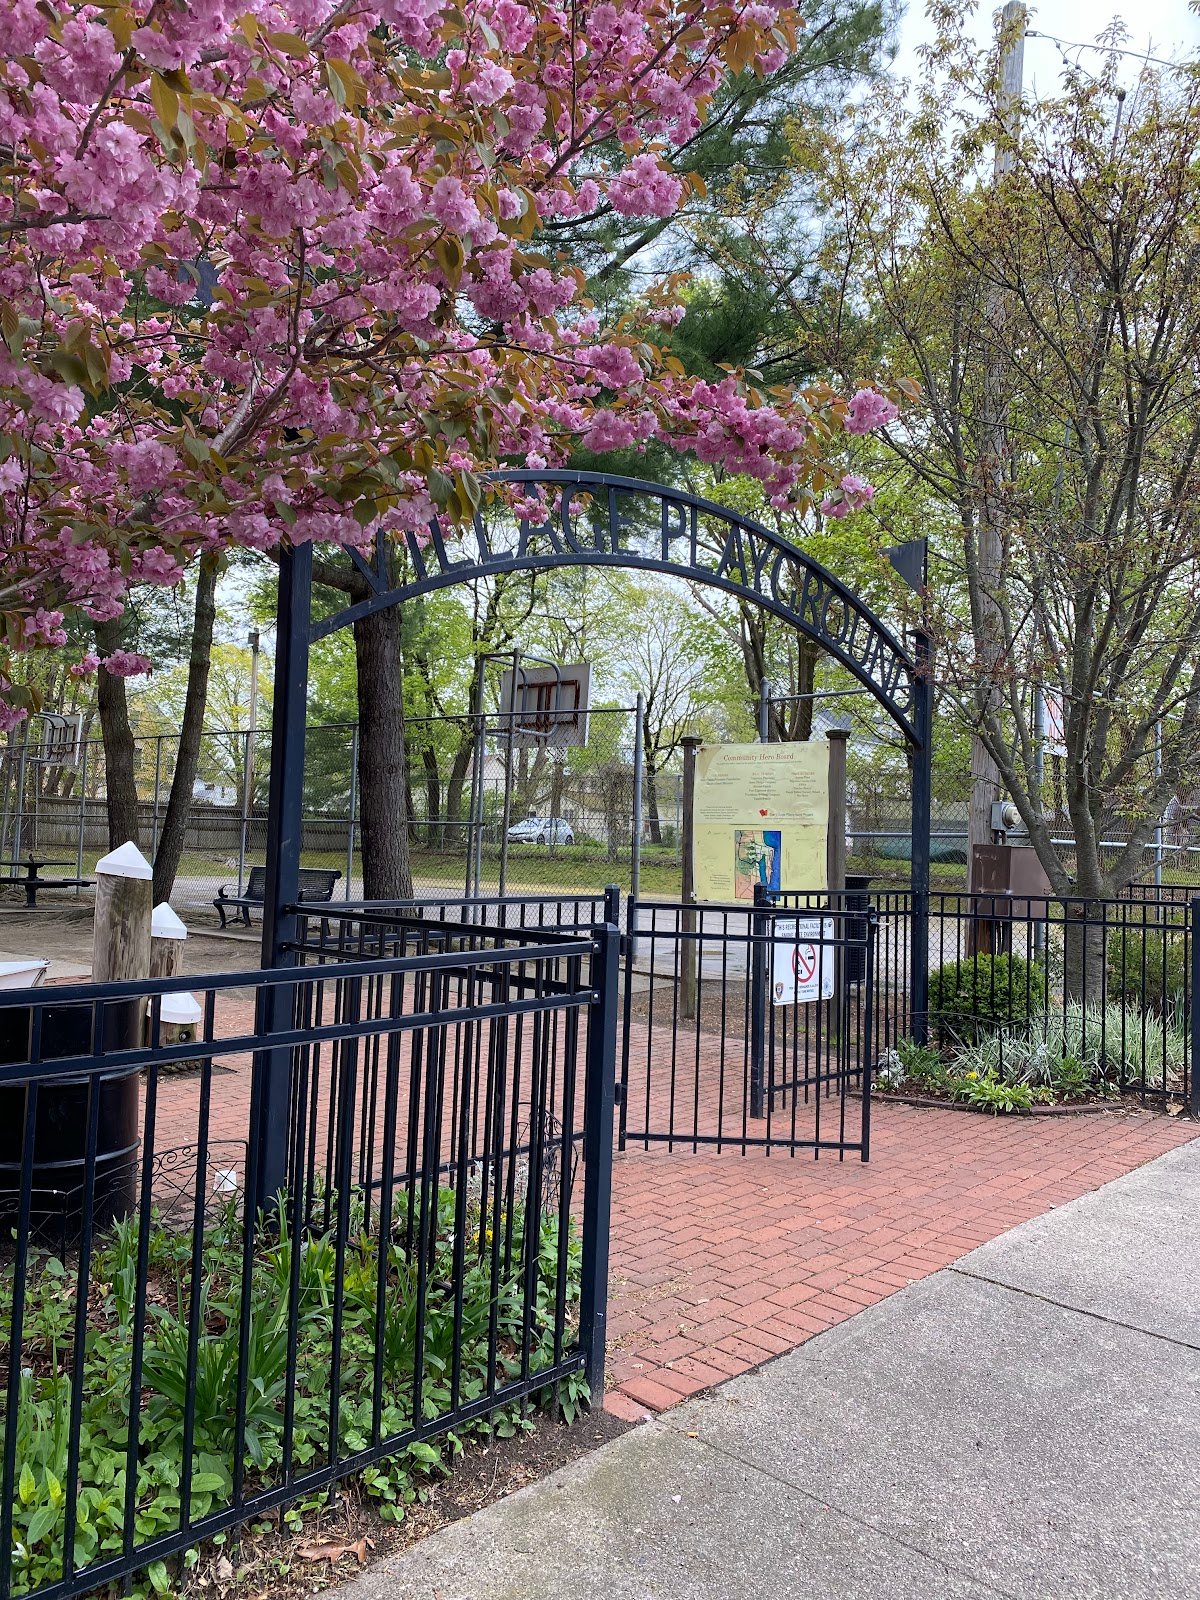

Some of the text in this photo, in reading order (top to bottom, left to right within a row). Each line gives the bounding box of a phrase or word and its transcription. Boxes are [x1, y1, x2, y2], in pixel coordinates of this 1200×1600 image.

[341, 480, 916, 714] VILLAGE PLAYGROUND
[723, 752, 794, 762] Community Hero Board
